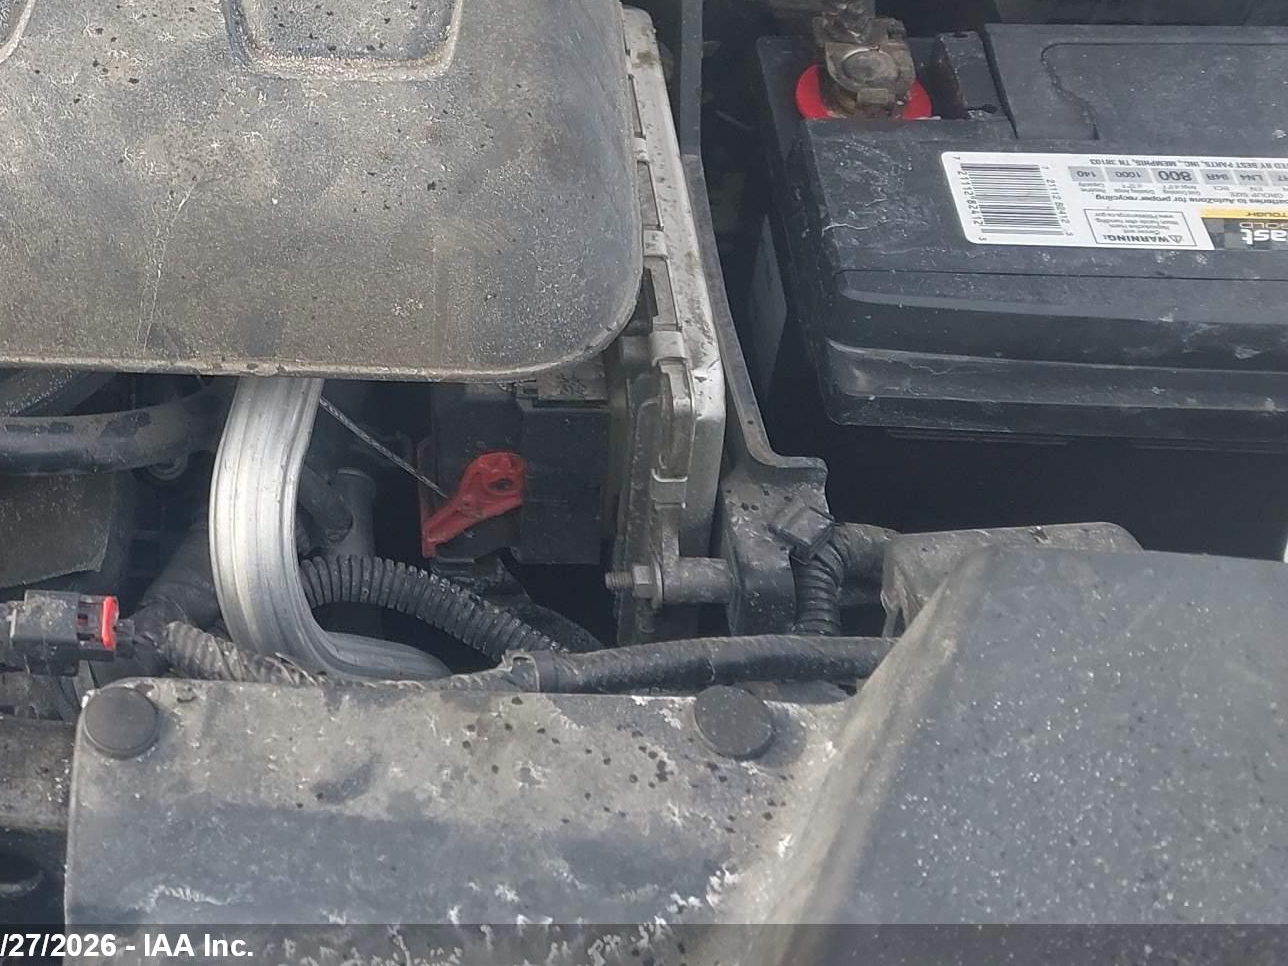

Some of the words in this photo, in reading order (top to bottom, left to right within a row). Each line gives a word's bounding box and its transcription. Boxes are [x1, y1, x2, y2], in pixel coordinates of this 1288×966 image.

[1131, 159, 1177, 167] MEMPHIS,
[1200, 160, 1234, 168] PARTS,
[1158, 171, 1193, 182] 800
[1095, 194, 1138, 202] recycling
[1102, 235, 1170, 243] WARNING:
